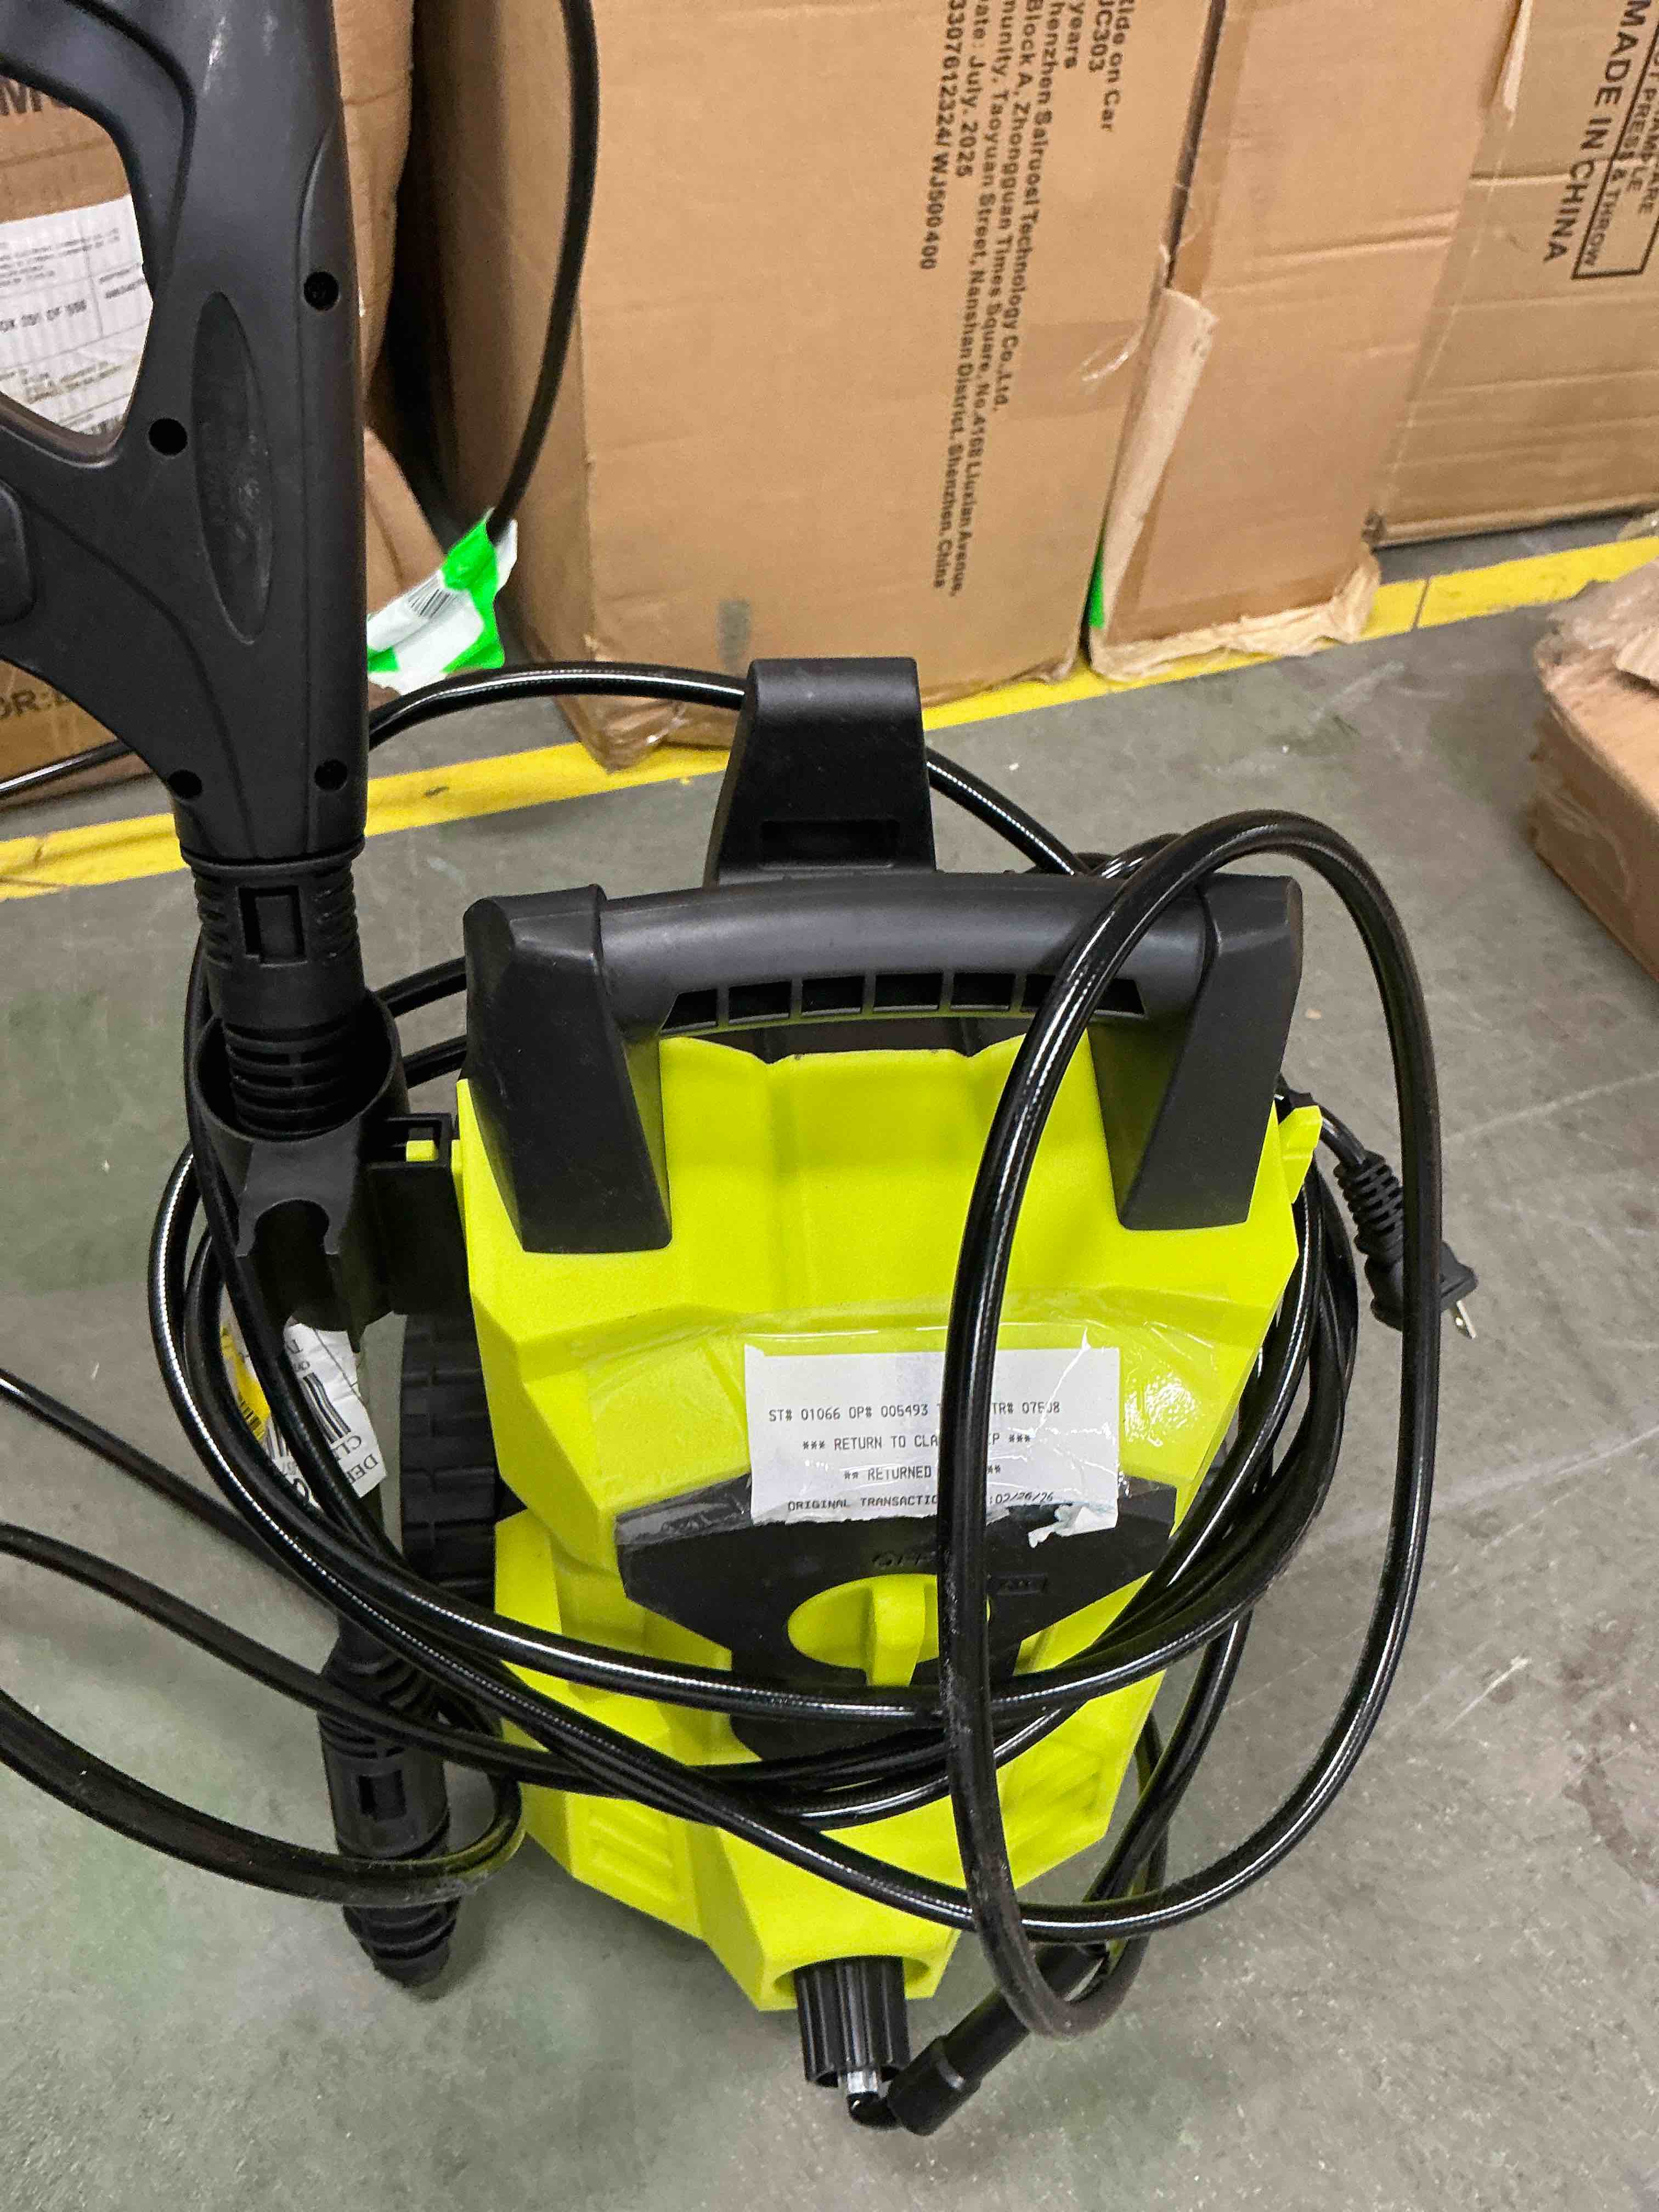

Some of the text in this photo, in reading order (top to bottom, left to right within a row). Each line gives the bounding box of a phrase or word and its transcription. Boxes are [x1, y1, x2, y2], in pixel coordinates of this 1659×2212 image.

[1020, 0, 1044, 65] Block
[1064, 2, 1085, 69] years
[1107, 53, 1124, 83] on
[982, 88, 1009, 187] Taoyuan
[1101, 89, 1121, 132] Car
[1543, 0, 1652, 263] MADE IN CHINA
[956, 121, 979, 177] 2025
[998, 101, 1031, 229] Zhongguan
[969, 193, 996, 266] Street,
[989, 233, 1014, 297] Times
[1002, 210, 1040, 329] Technology
[960, 270, 986, 359] Nanshan
[933, 539, 953, 589] China
[769, 1408, 793, 1421] ST#
[801, 1407, 840, 1421] 01066
[849, 1406, 872, 1419] OP#
[881, 1403, 928, 1418] 005493
[991, 1402, 1014, 1415] TR#
[834, 1435, 882, 1451] RETURN
[890, 1435, 906, 1448] TO
[788, 1499, 850, 1512] ORIGINAL
[860, 1494, 939, 1508] TRANSACTIO
[868, 1465, 932, 1481] RETURNED
